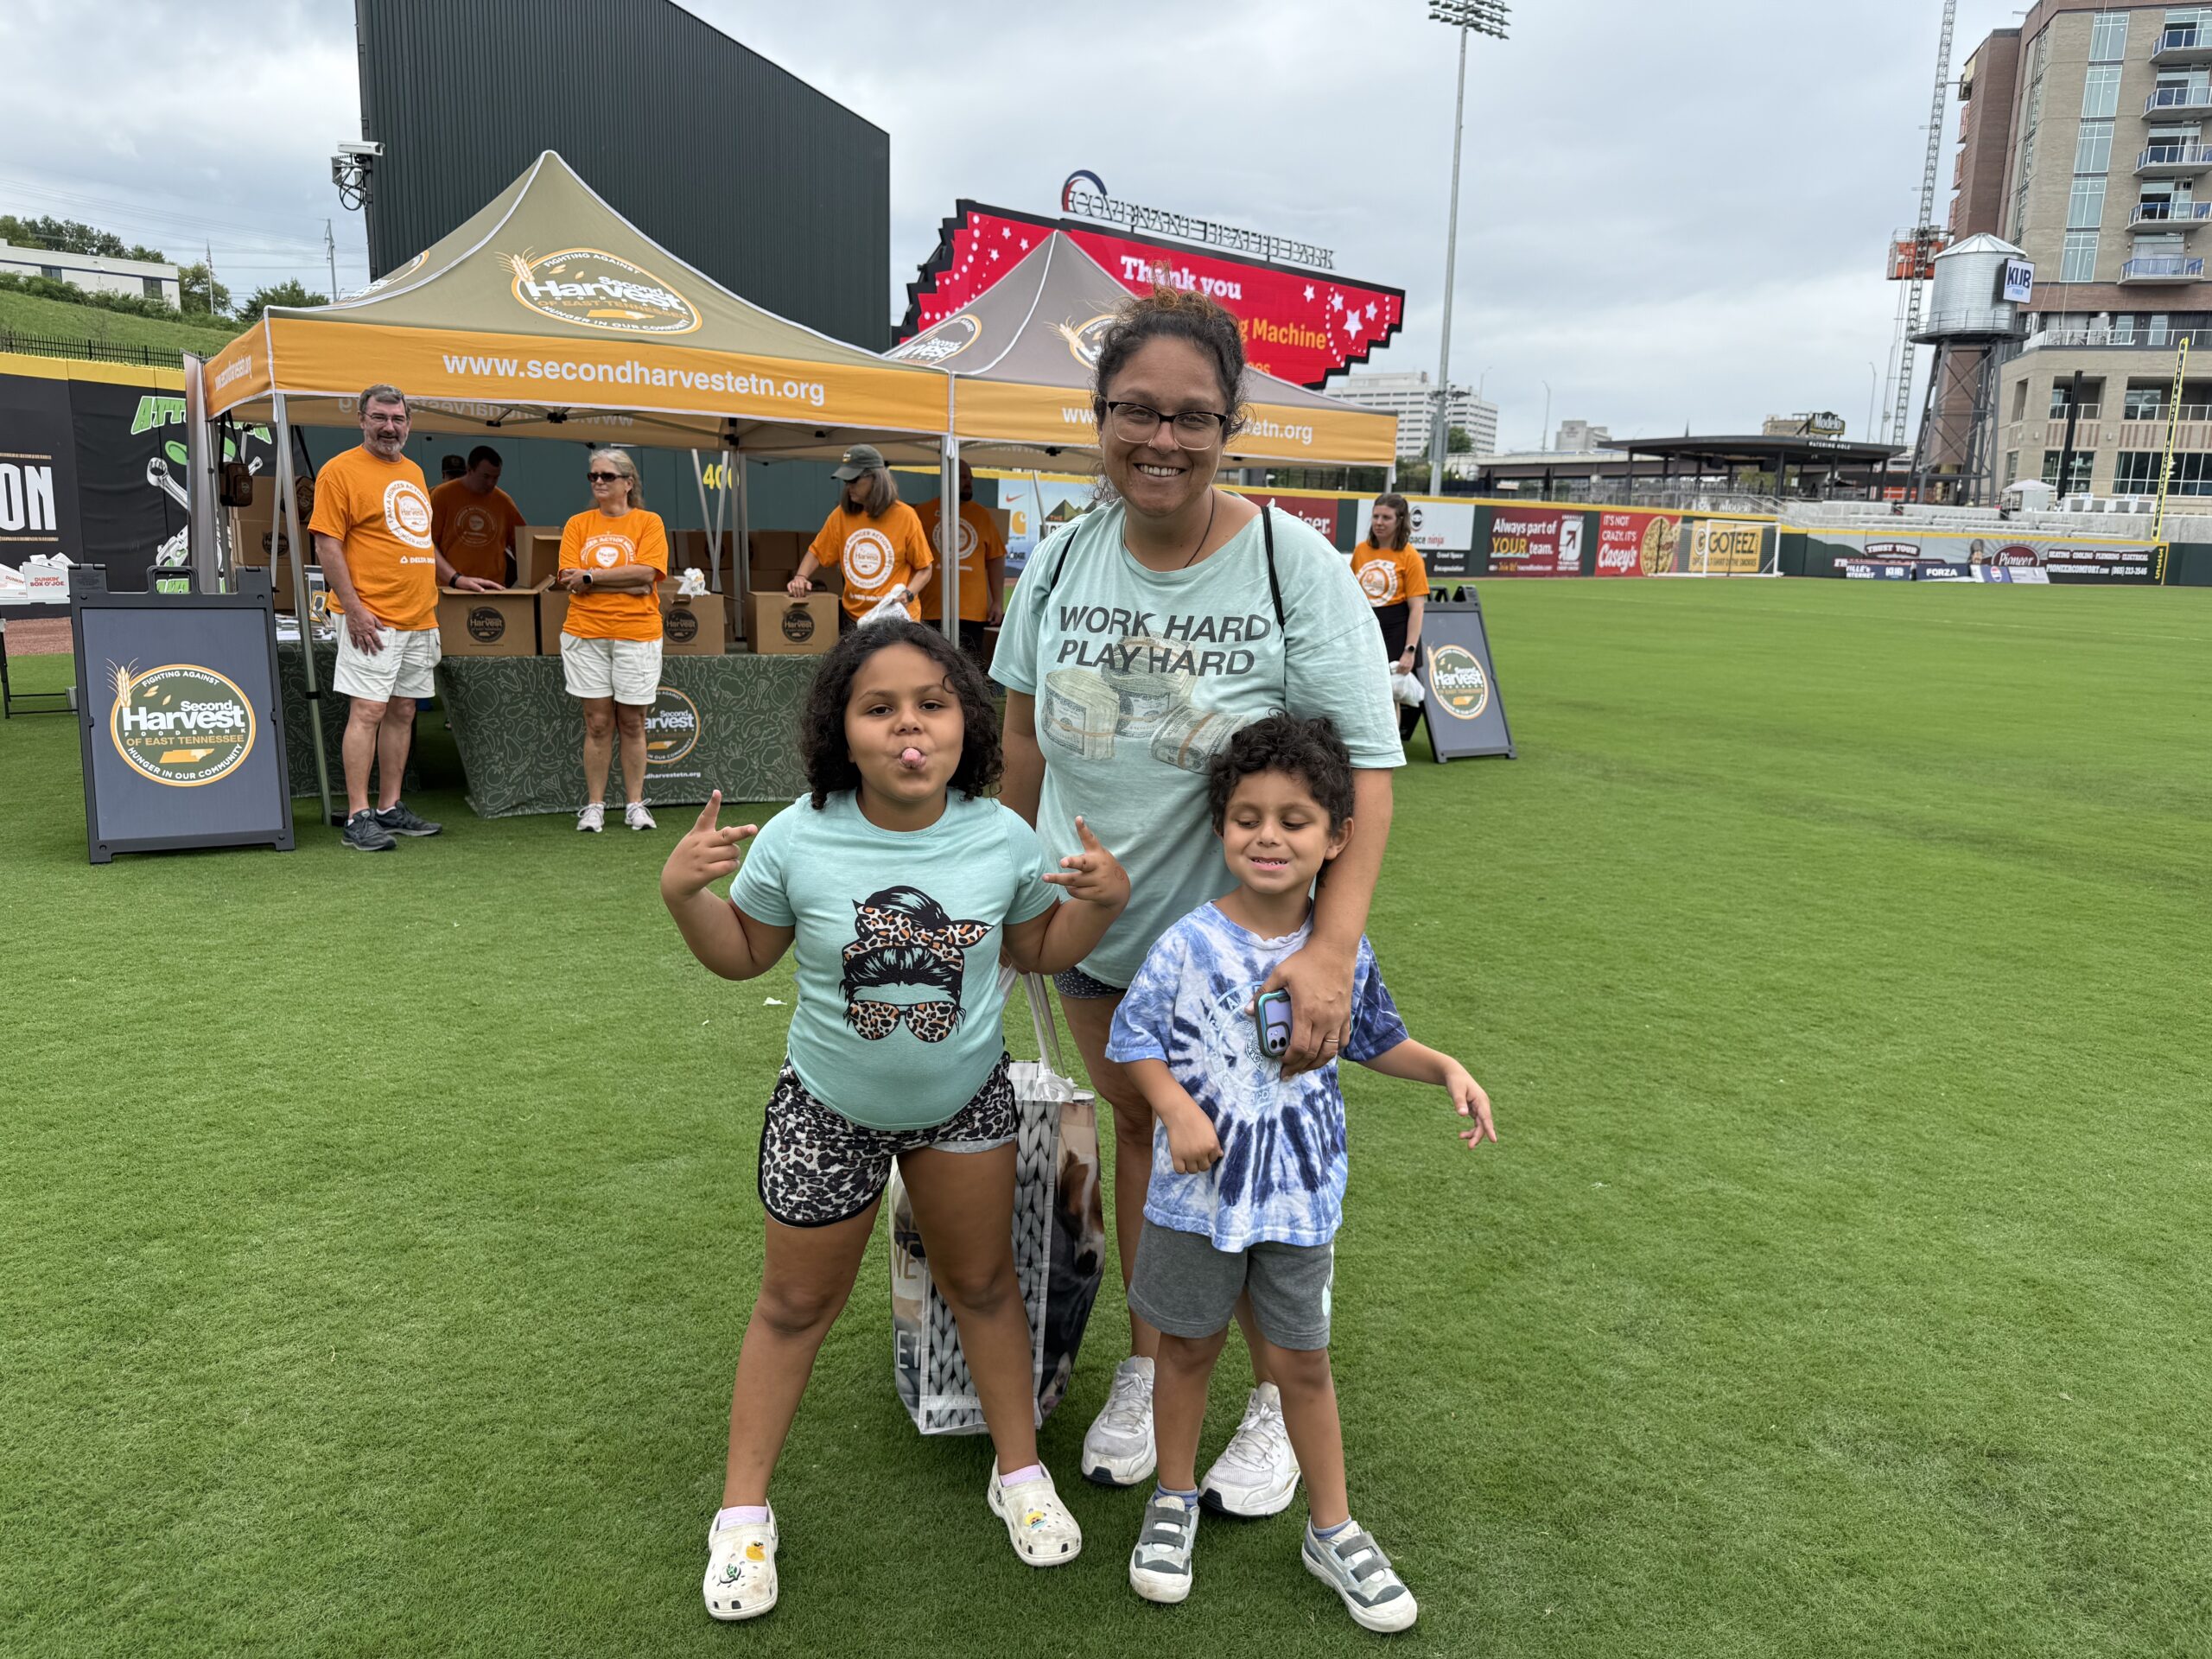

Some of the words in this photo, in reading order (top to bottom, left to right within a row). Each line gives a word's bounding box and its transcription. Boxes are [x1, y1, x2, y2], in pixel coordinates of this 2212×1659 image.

[543, 252, 591, 268] FIGHTING
[593, 254, 642, 276] AGAINST
[1293, 240, 1336, 270] PARK
[597, 276, 664, 296] Second
[2006, 266, 2032, 289] KUB
[524, 280, 687, 312] Harvest
[1199, 276, 1243, 301] you
[541, 305, 591, 324] HUNGER
[612, 321, 640, 330] OUR
[562, 300, 601, 308] EAST
[604, 300, 690, 320] TENNESSEE
[1252, 317, 1327, 350] Machine
[442, 353, 825, 407] www.secondharvestetn.org
[1814, 413, 1842, 429] Modelo
[386, 482, 404, 499] HUNGER
[1492, 518, 1526, 537] Always
[1527, 521, 1546, 537] part
[1546, 520, 1558, 535] of
[1603, 514, 1615, 526] IT'S
[1615, 515, 1630, 526] NOT
[1427, 533, 1445, 547] ninja
[1491, 537, 1528, 554] YOUR
[1529, 541, 1554, 556] team.
[1624, 531, 1637, 543] IT'S
[1708, 531, 1756, 554] GOTEEZ
[1599, 543, 1638, 573] Casey's
[1866, 543, 1894, 554] TRUST
[1895, 543, 1918, 556] YOUR
[1999, 550, 2034, 567] Pioneer
[2072, 550, 2094, 560] COOLING
[1885, 566, 1904, 576] KUB
[1926, 567, 1958, 577] FORZA
[470, 618, 502, 627] Harvest
[1059, 605, 1158, 638] WORK
[1162, 613, 1272, 643] HARD
[1056, 639, 1143, 672] PLAY
[1148, 649, 1255, 677] HARD
[142, 670, 181, 688] FIGHTING
[182, 671, 220, 686] AGAINST
[1433, 670, 1483, 687] Harvest
[180, 699, 233, 712] Second
[659, 709, 689, 718] Second
[121, 705, 245, 731] Harvest
[645, 713, 695, 730] arvest
[125, 738, 143, 747] OF
[145, 736, 175, 747] EAST
[178, 734, 245, 745] TENNESSEE
[127, 747, 161, 775] HUNGER
[162, 769, 173, 779] IN
[175, 772, 196, 780] OUR
[198, 743, 243, 778] COMMUNITY
